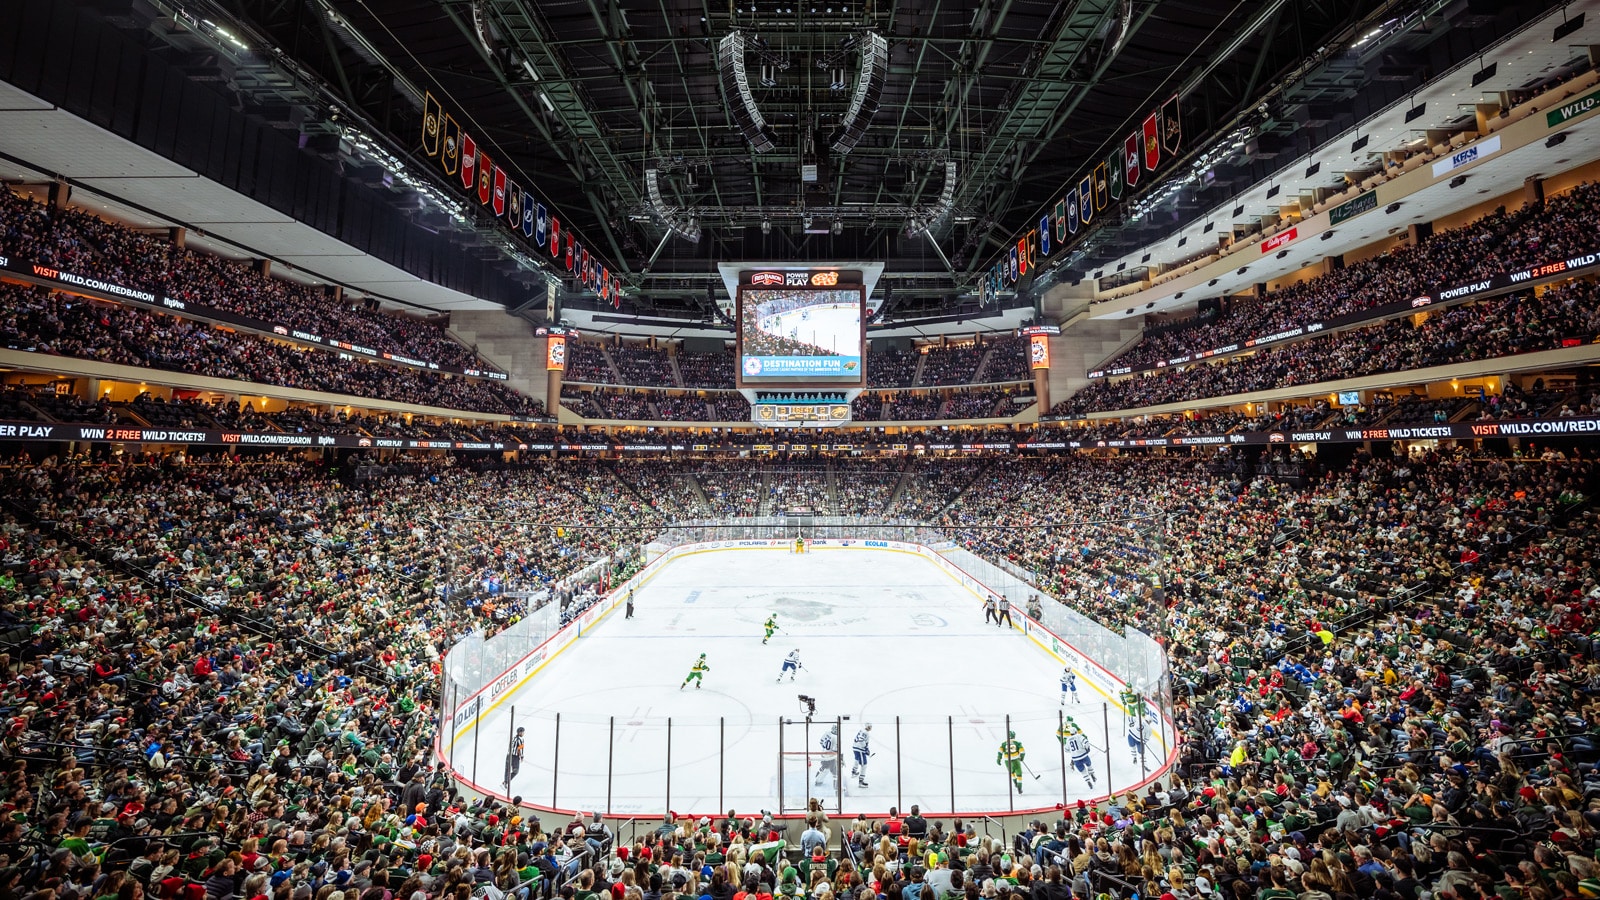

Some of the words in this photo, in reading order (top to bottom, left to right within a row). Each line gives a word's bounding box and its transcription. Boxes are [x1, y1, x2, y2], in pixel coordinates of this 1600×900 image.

[1510, 270, 1531, 282] WIN
[1532, 268, 1539, 277] 2
[1540, 262, 1566, 275] FREE
[1566, 254, 1596, 269] WILD
[33, 265, 59, 279] VISIT
[59, 271, 155, 303] WILD.COM/REDBARON
[1440, 285, 1470, 300] POWER
[1470, 280, 1491, 293] PLAY
[293, 330, 311, 341] POWER
[310, 334, 322, 343] PLAY
[764, 360, 823, 368] DESTINATION
[824, 360, 841, 368] FUN
[19, 426, 53, 437] PLAY
[80, 428, 105, 439] WIN
[106, 429, 114, 439] 2
[115, 430, 141, 440] FREE
[142, 432, 167, 441] WILD
[168, 432, 206, 442] TICKETS!
[1292, 432, 1314, 441] POWER
[1315, 431, 1331, 440] PLAY
[1345, 430, 1362, 439] WIN
[1362, 430, 1369, 438] 2
[1369, 429, 1388, 438] FREE
[1388, 428, 1410, 438] WILD
[1411, 426, 1451, 438] TICKETS!
[1471, 424, 1499, 435] VISIT
[221, 433, 240, 443] VISIT
[241, 434, 311, 445] WILD.COM/REDBARON
[491, 669, 518, 698] LOFFLER
[464, 698, 484, 721] LIGT
